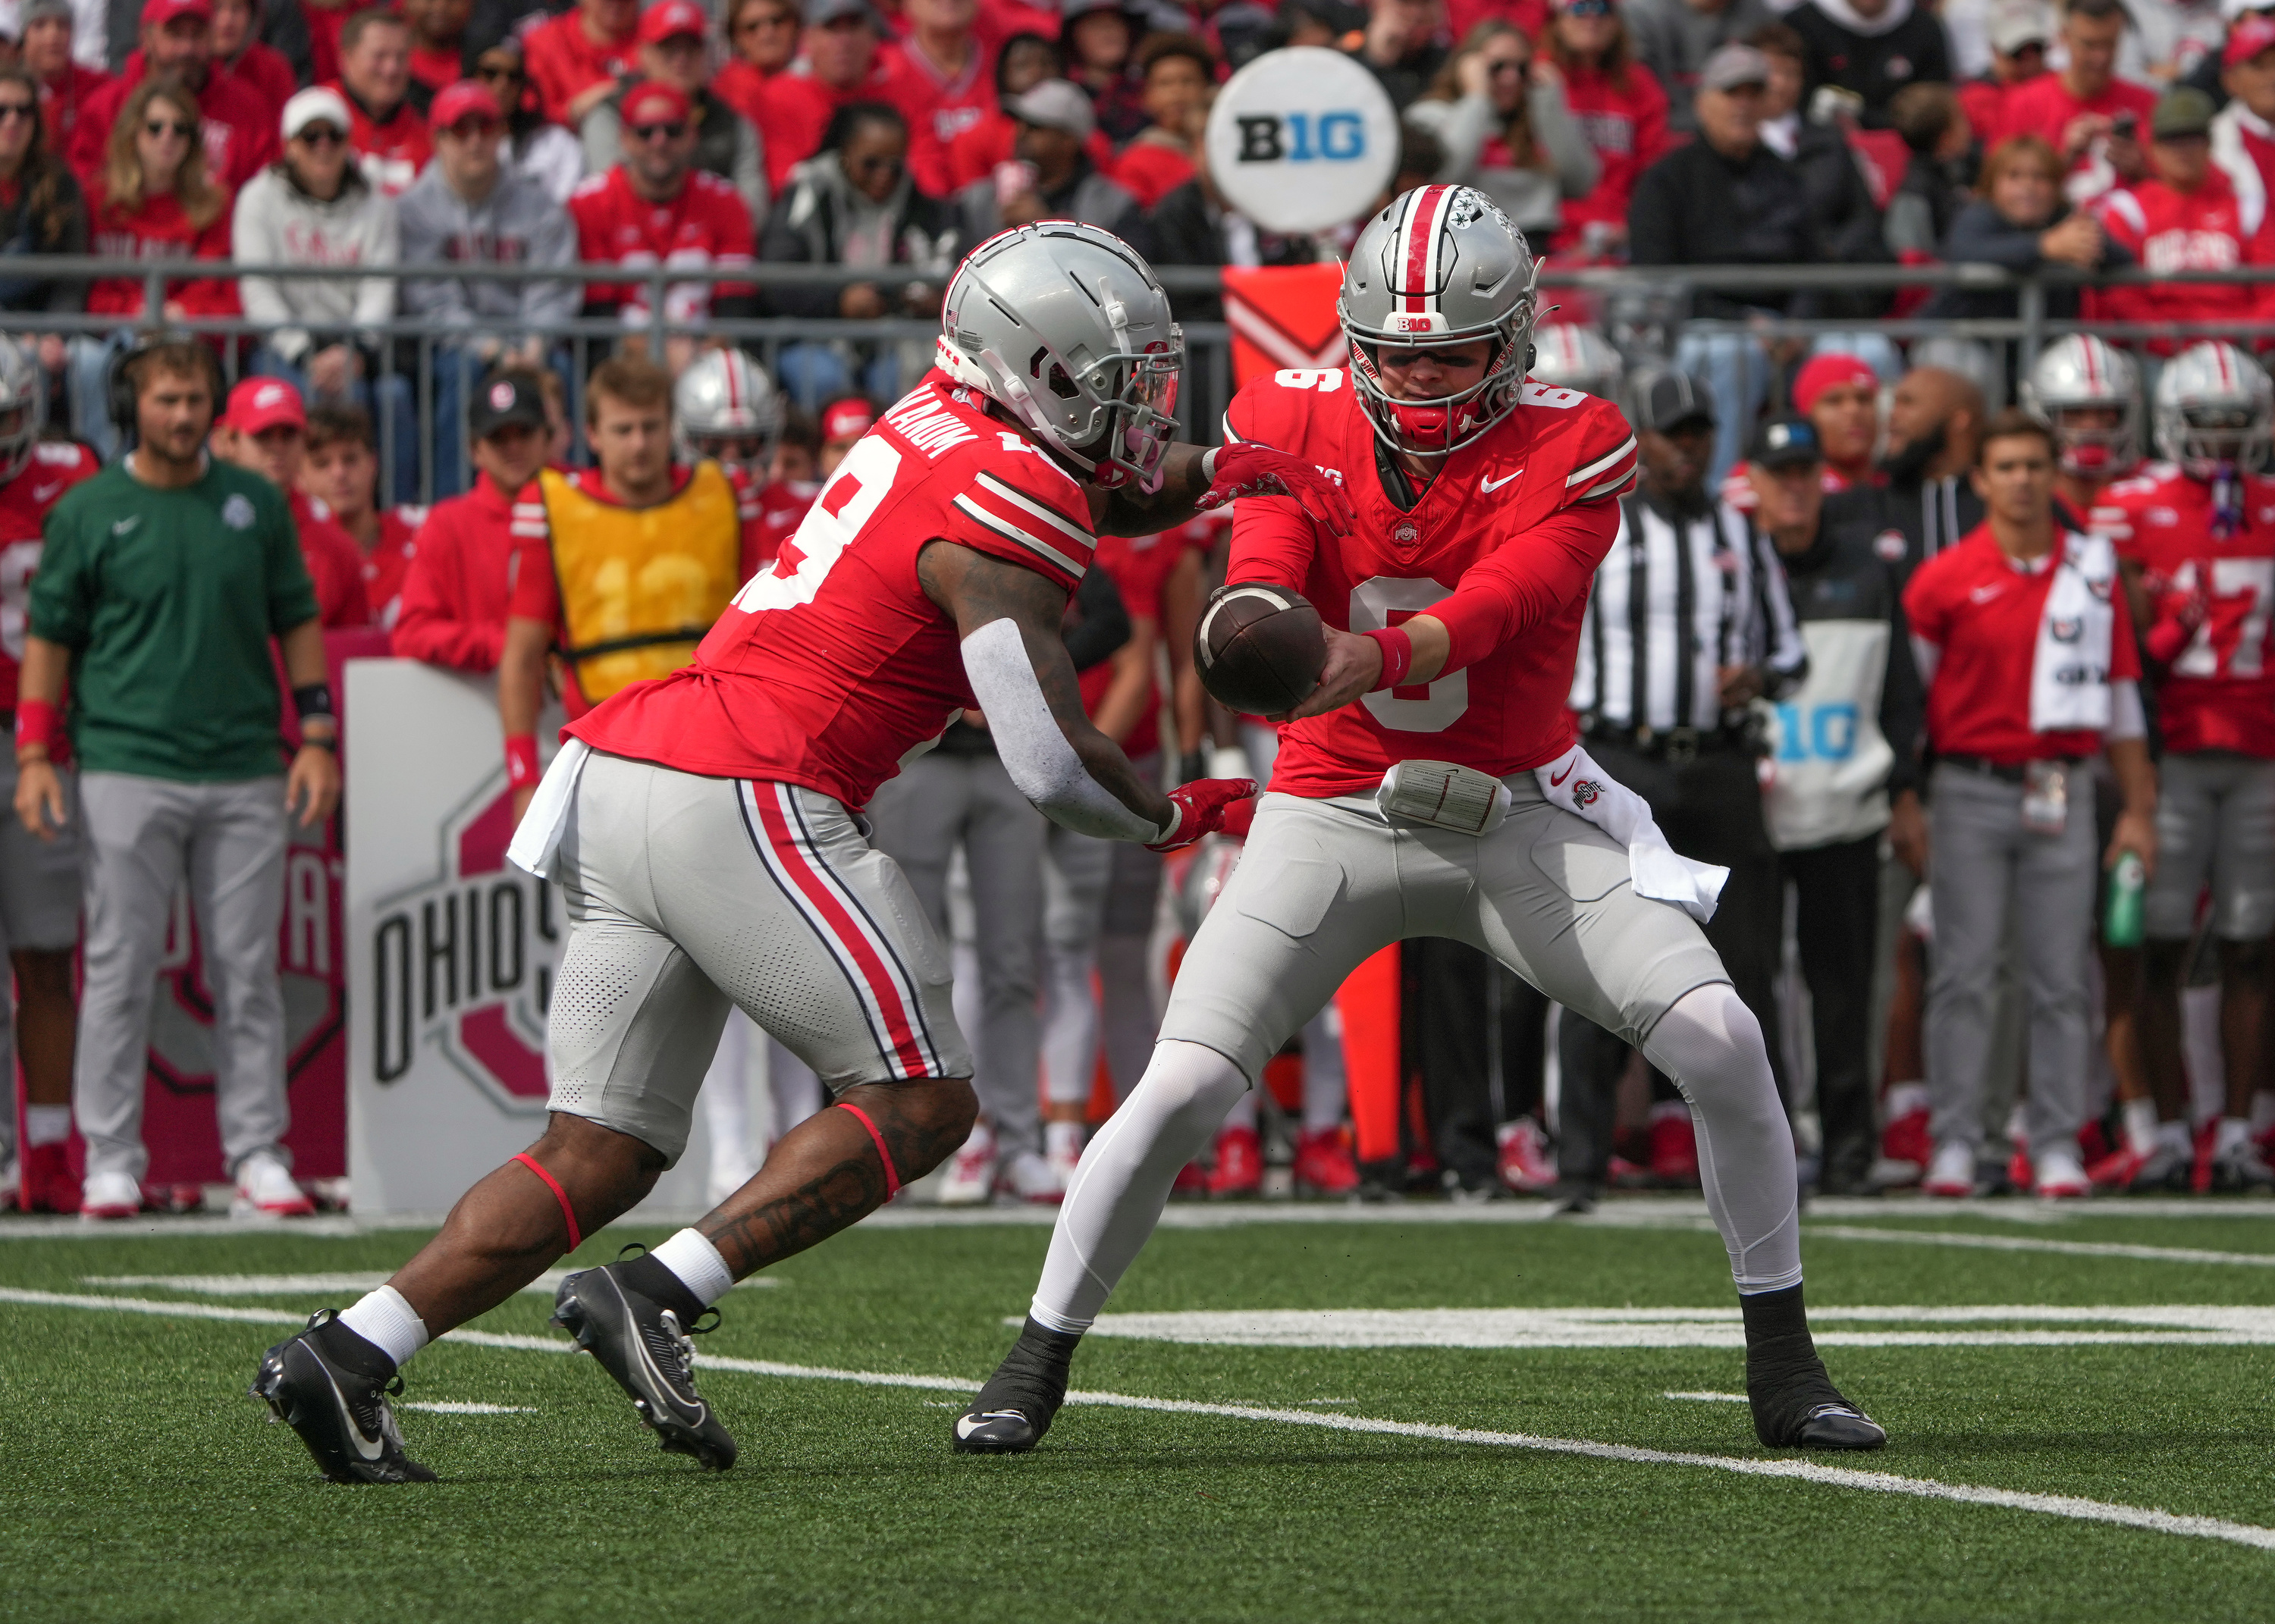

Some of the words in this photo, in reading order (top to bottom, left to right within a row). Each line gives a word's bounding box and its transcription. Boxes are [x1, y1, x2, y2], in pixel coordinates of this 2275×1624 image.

[1352, 343, 1365, 360] OHIO
[1360, 359, 1379, 381] STATE
[1348, 575, 1470, 732] 6
